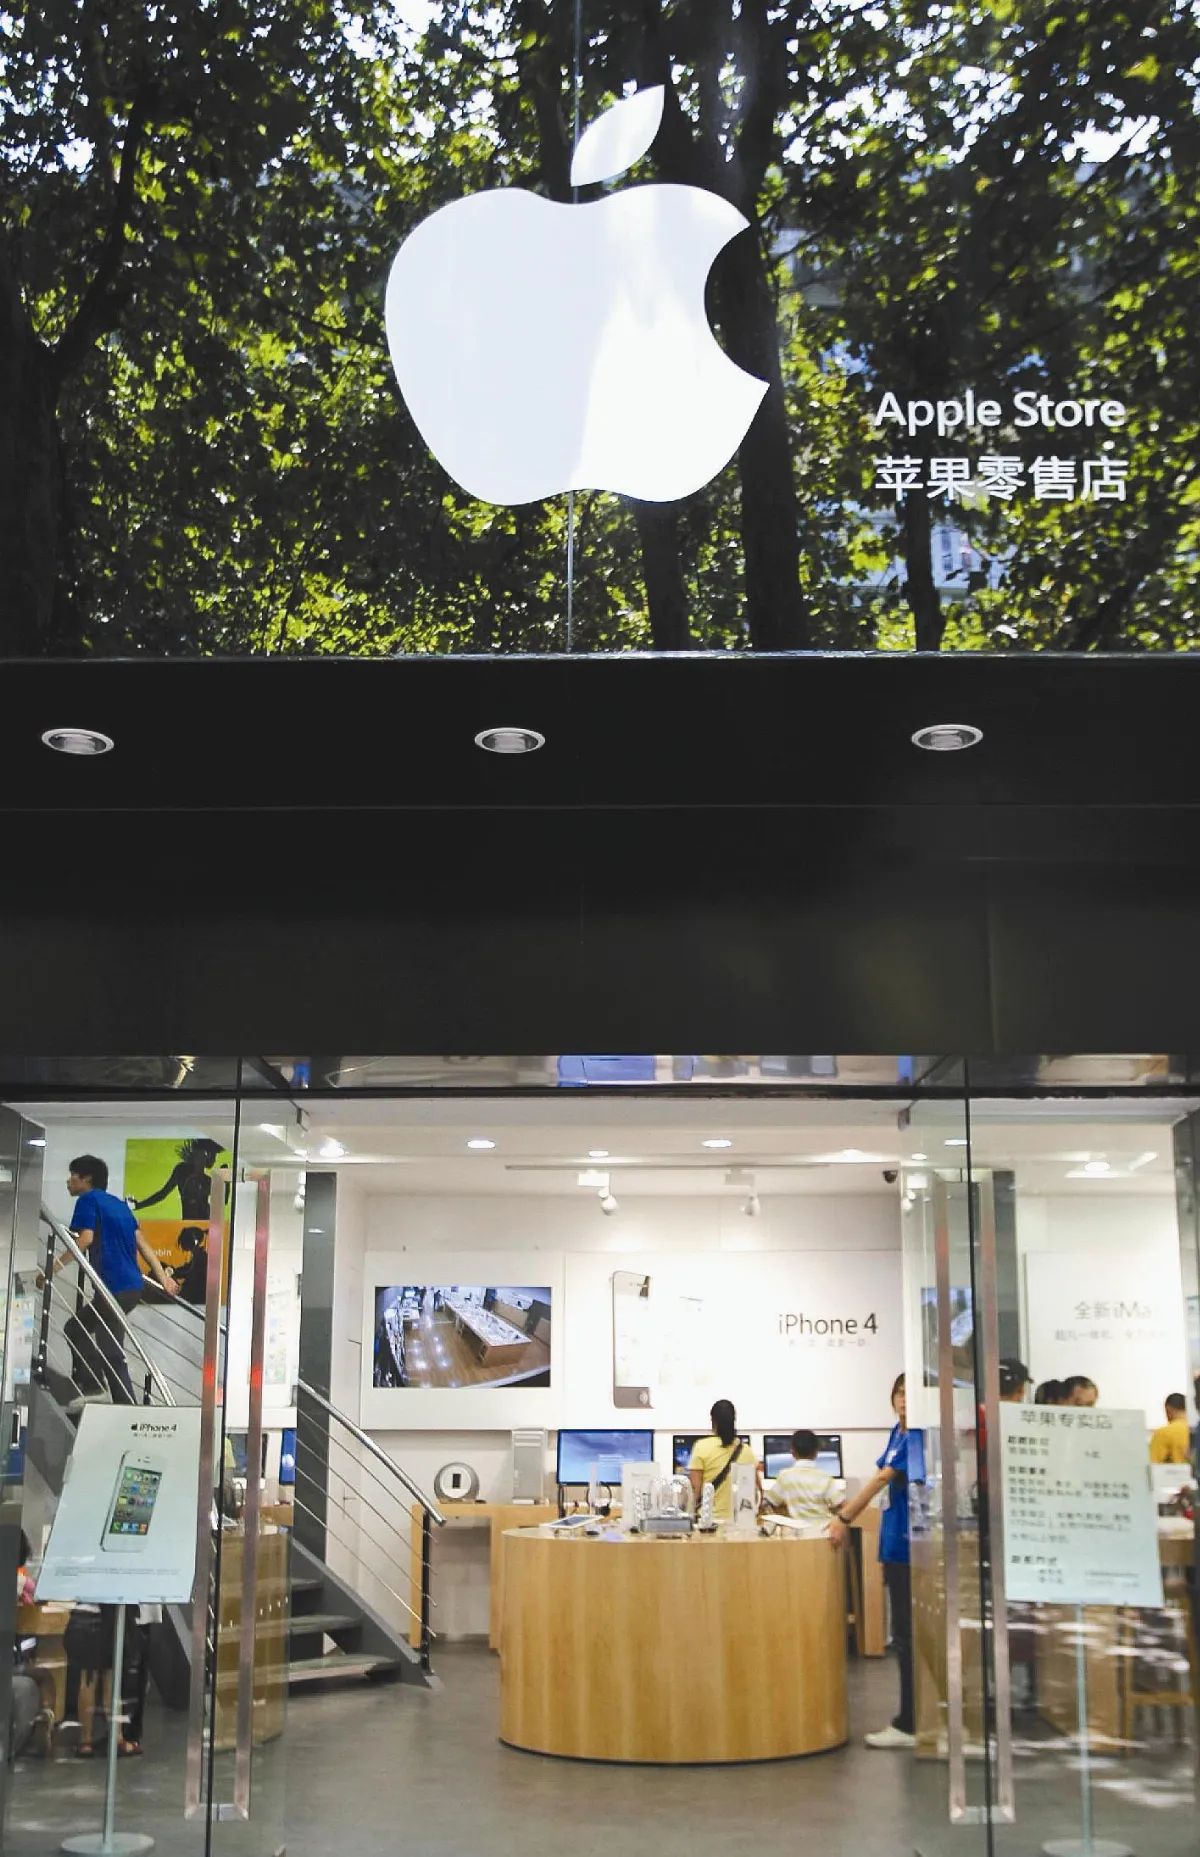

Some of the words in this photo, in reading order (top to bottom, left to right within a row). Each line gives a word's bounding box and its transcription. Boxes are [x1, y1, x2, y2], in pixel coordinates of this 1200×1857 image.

[874, 389, 1001, 437] Apple
[1014, 391, 1126, 427] Store
[873, 455, 1129, 501] 苹果零售店
[779, 1313, 858, 1335] iPhone
[863, 1312, 879, 1335] 4
[139, 1423, 170, 1432] iPhone
[170, 1423, 177, 1432] 4
